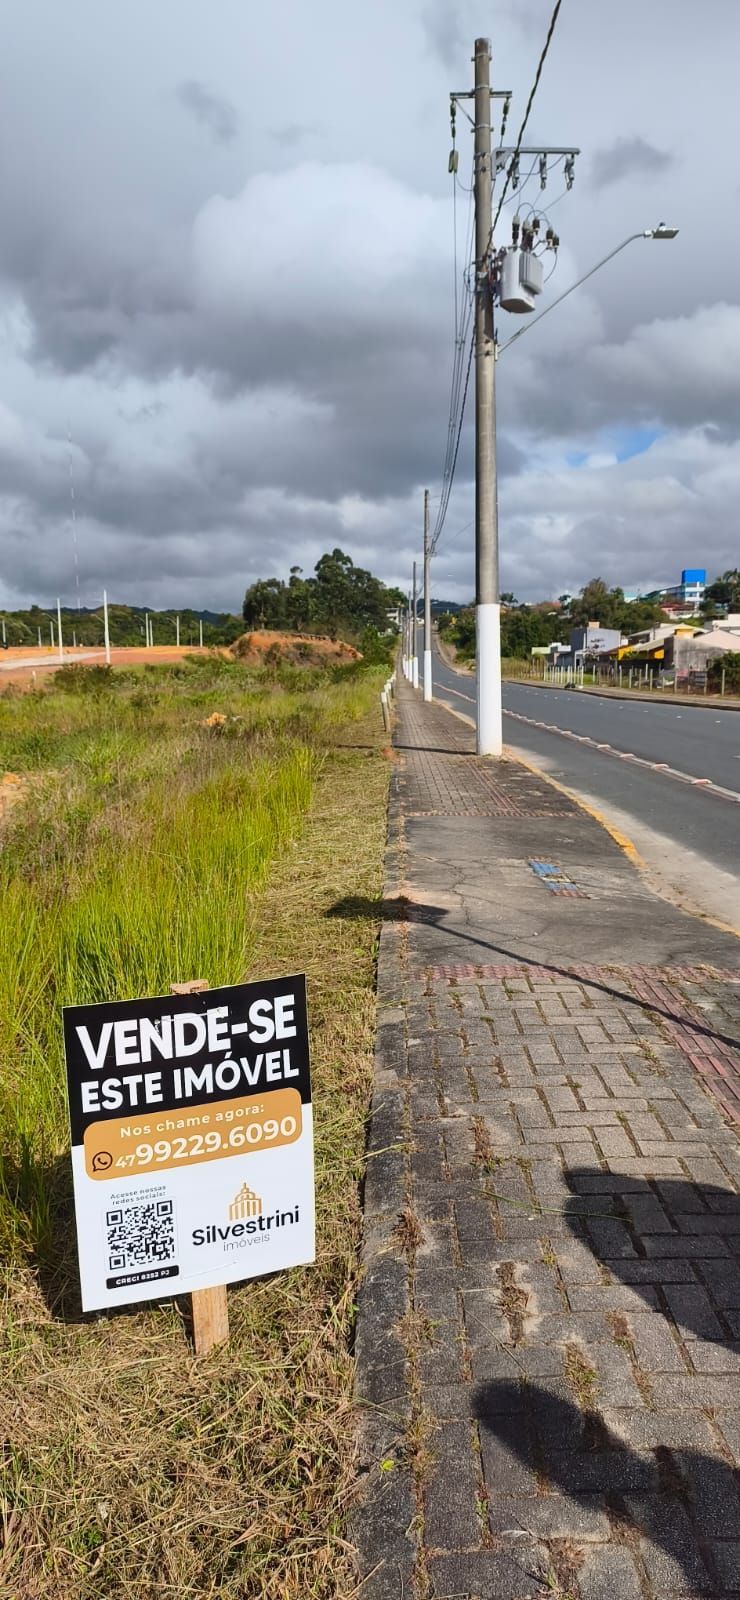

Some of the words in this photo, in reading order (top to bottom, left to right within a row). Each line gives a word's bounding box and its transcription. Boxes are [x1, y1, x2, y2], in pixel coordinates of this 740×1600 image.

[75, 994, 297, 1070] VENDE-SE
[80, 1072, 164, 1113] ESTE
[173, 1049, 300, 1099] IMÓVEL
[120, 1125, 151, 1138] Nos
[156, 1114, 210, 1131] chame
[215, 1103, 265, 1123] agora:
[112, 1197, 135, 1206] redes
[139, 1185, 166, 1194] nossas
[192, 1205, 300, 1246] Silvestrini
[223, 1232, 271, 1252] imóveis
[115, 1276, 140, 1285] CRECI
